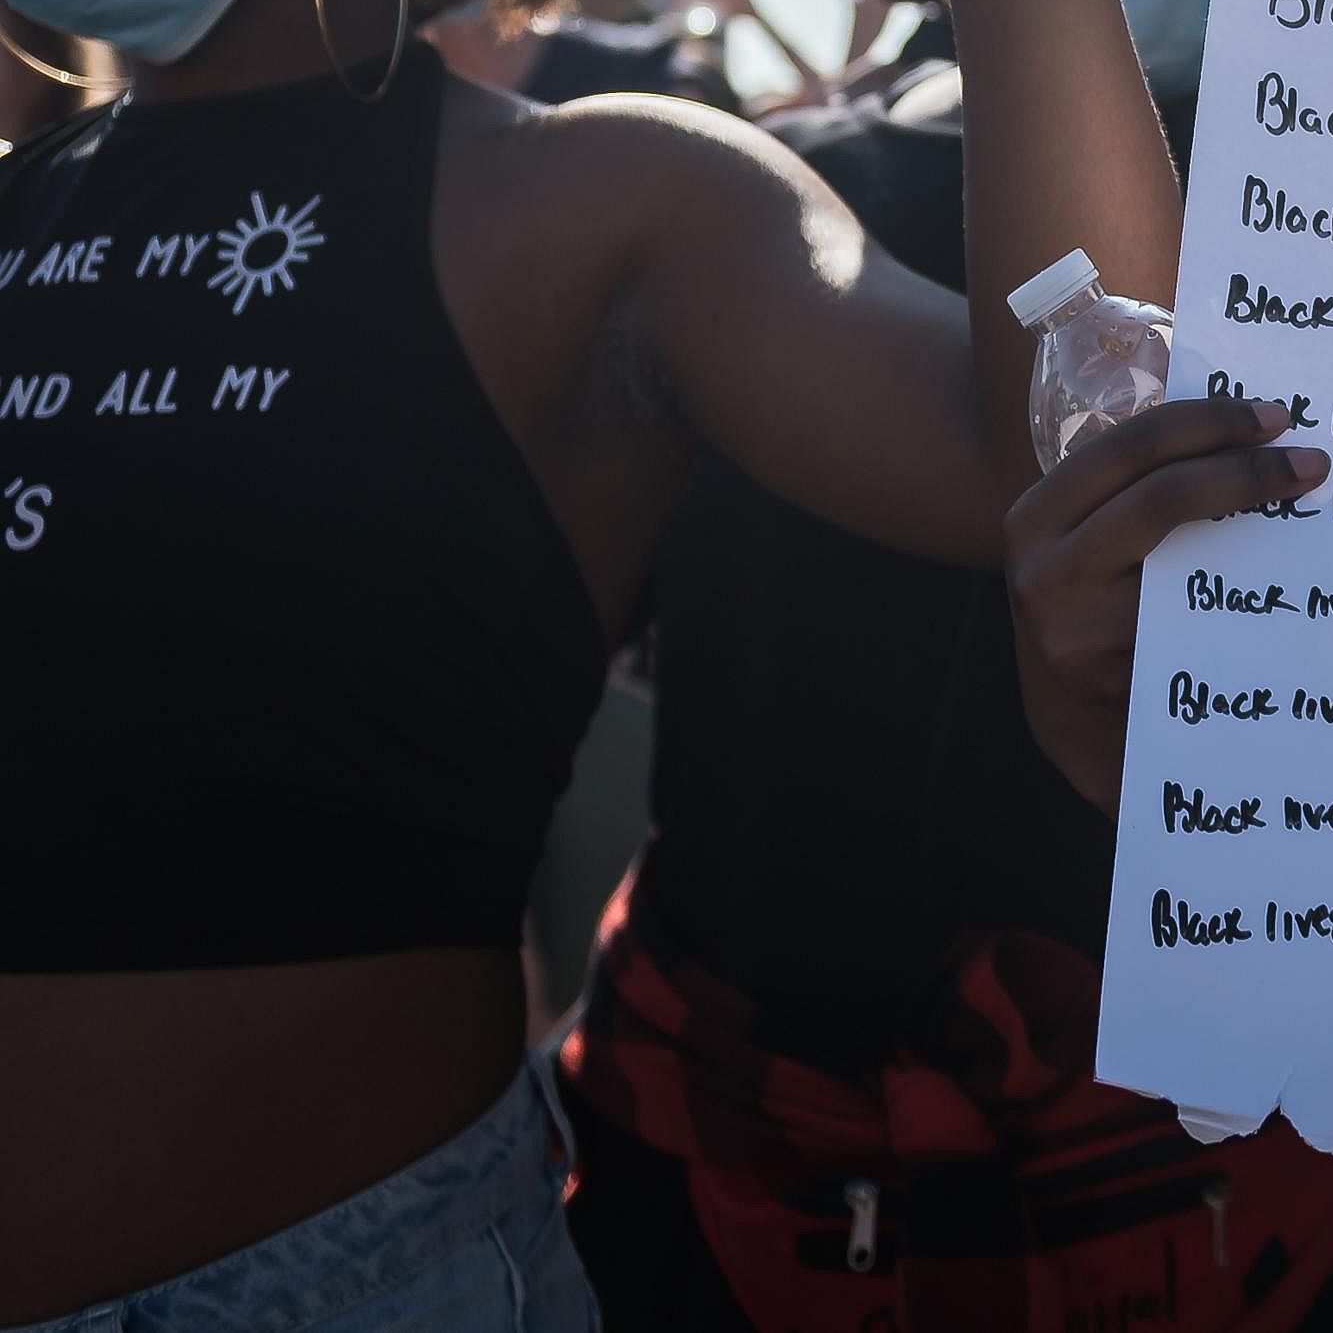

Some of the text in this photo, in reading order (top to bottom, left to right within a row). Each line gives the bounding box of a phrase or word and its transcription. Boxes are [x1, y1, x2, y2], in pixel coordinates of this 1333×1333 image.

[27, 234, 113, 287] ARE
[135, 233, 210, 278] MY
[0, 365, 291, 420] ND ALL MY
[1186, 568, 1301, 615] Black
[1168, 670, 1280, 726] Black
[1162, 780, 1267, 835] Black
[1151, 888, 1253, 948] Black
